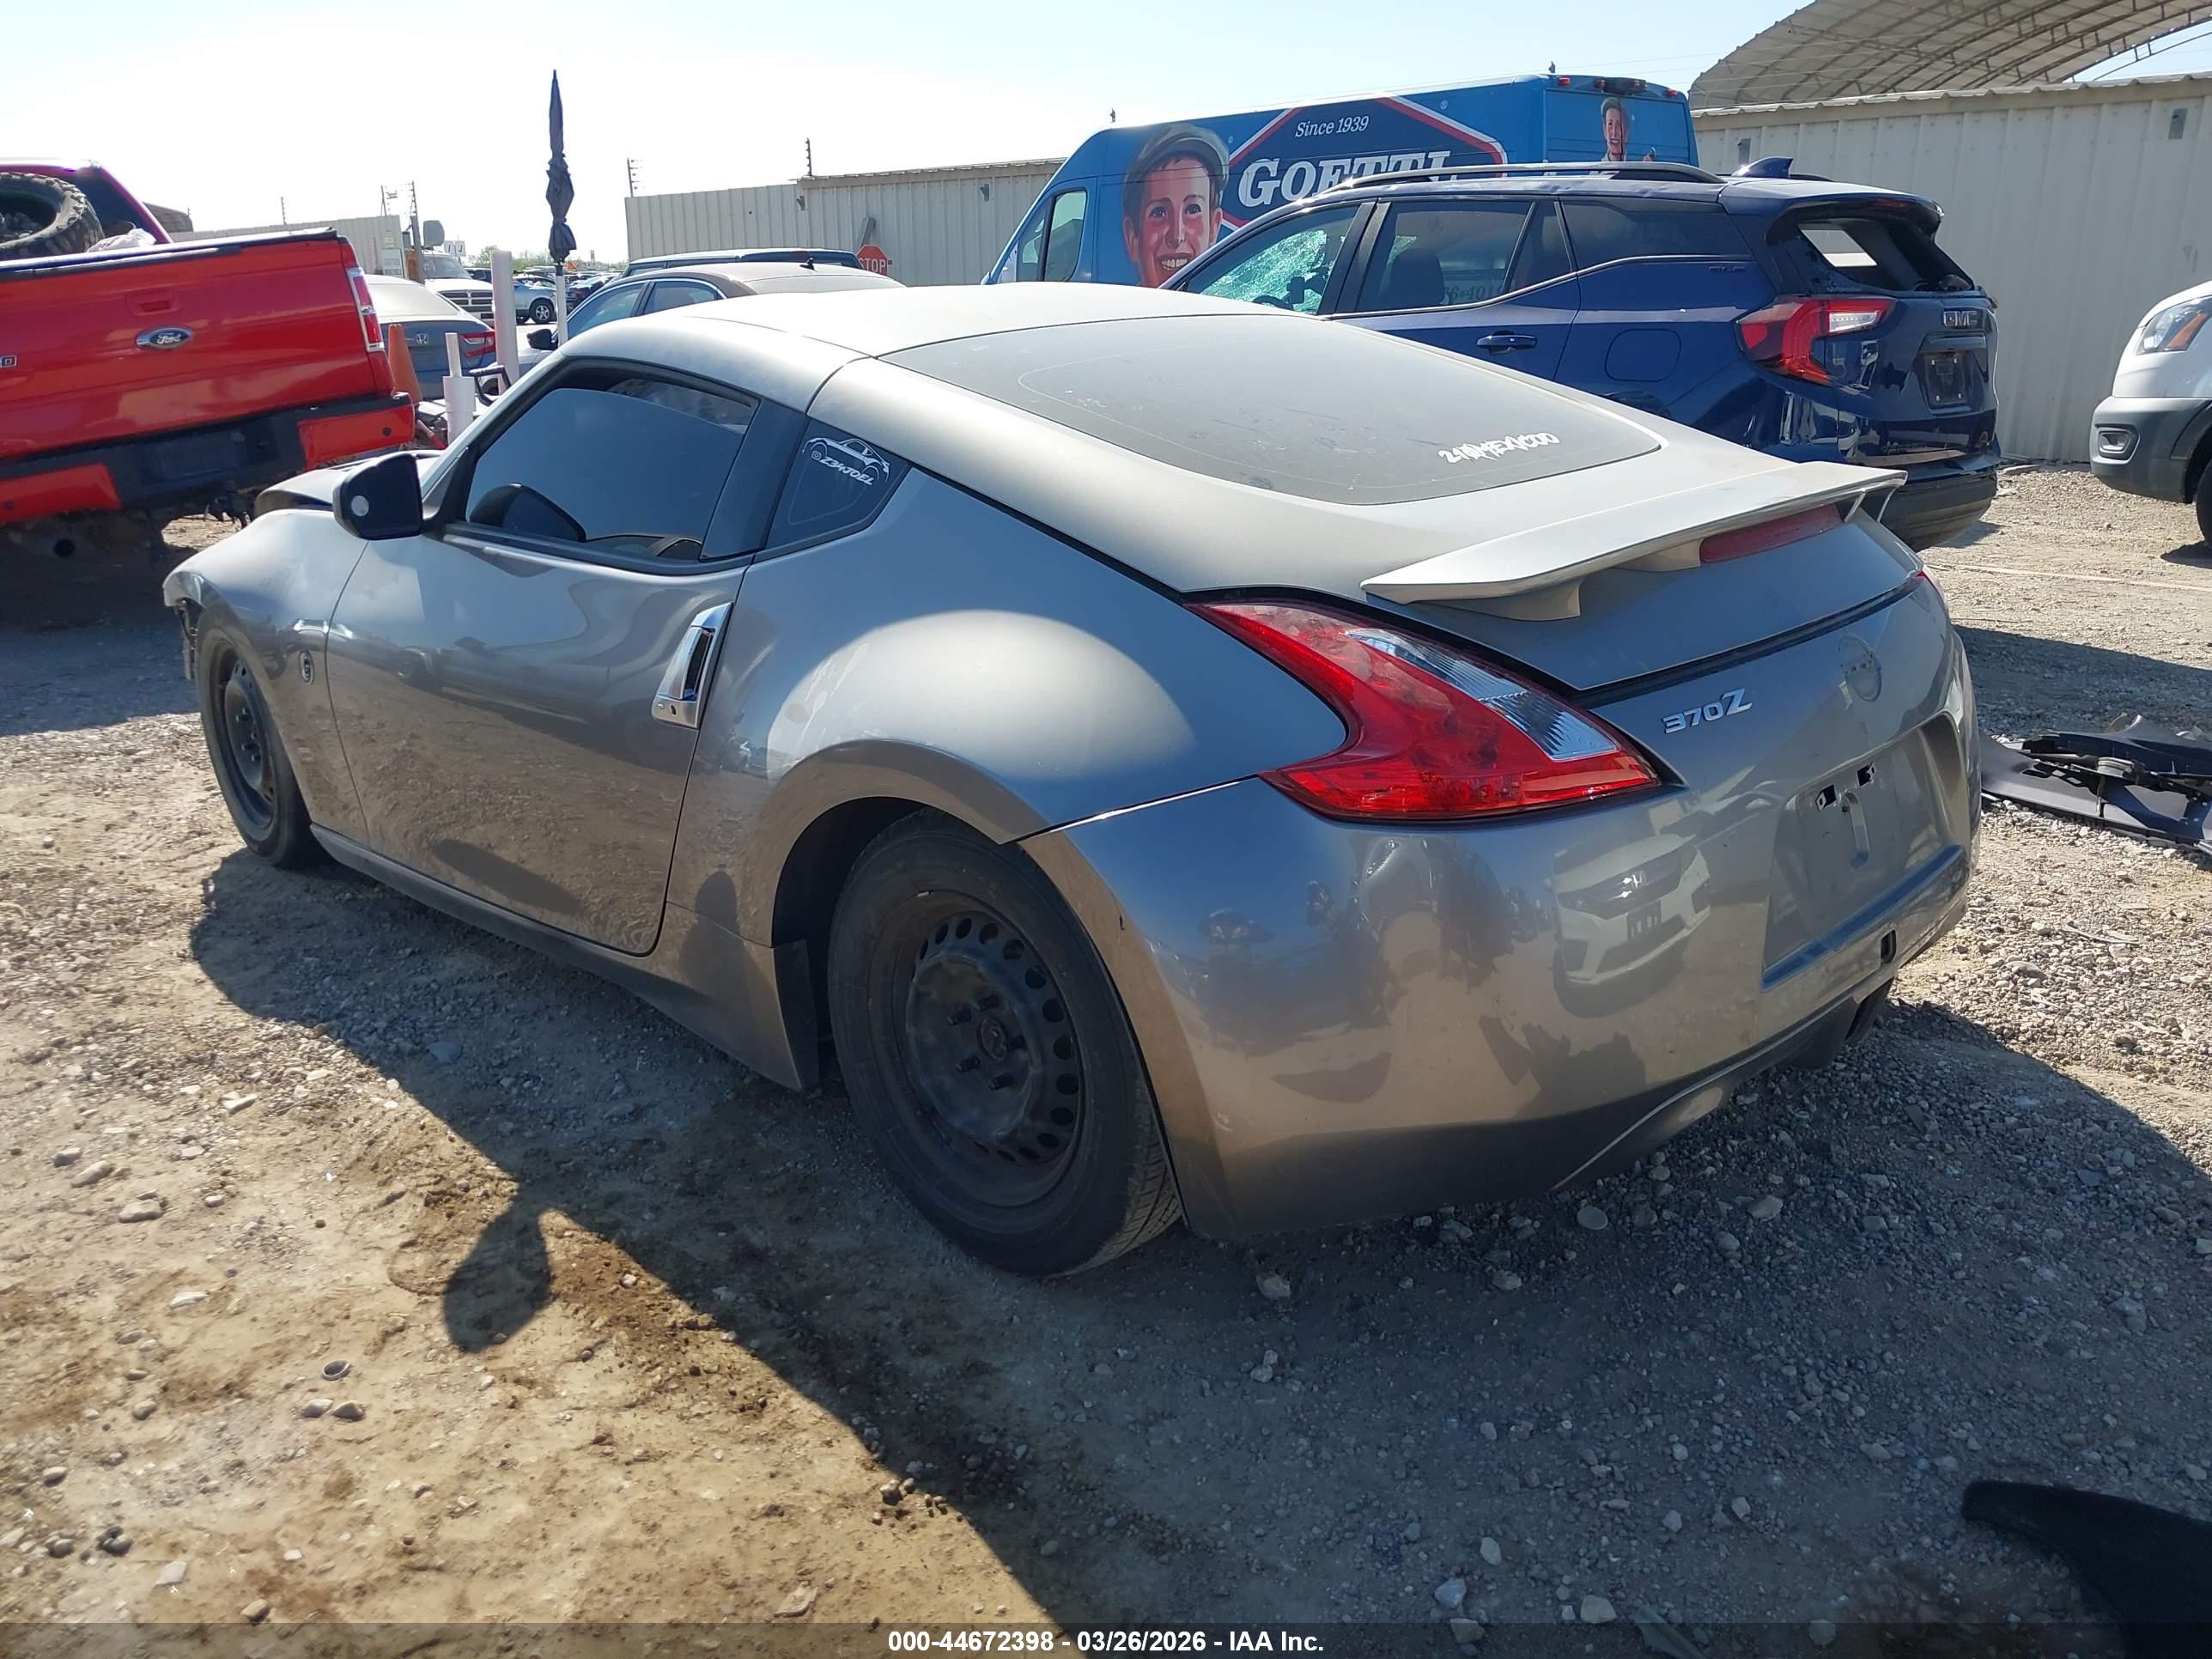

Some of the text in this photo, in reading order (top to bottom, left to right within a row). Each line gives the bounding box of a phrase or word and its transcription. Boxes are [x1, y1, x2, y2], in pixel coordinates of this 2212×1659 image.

[1295, 115, 1370, 137] Since 1939
[1943, 310, 1978, 326] GMC
[1662, 688, 1753, 734] 370Z
